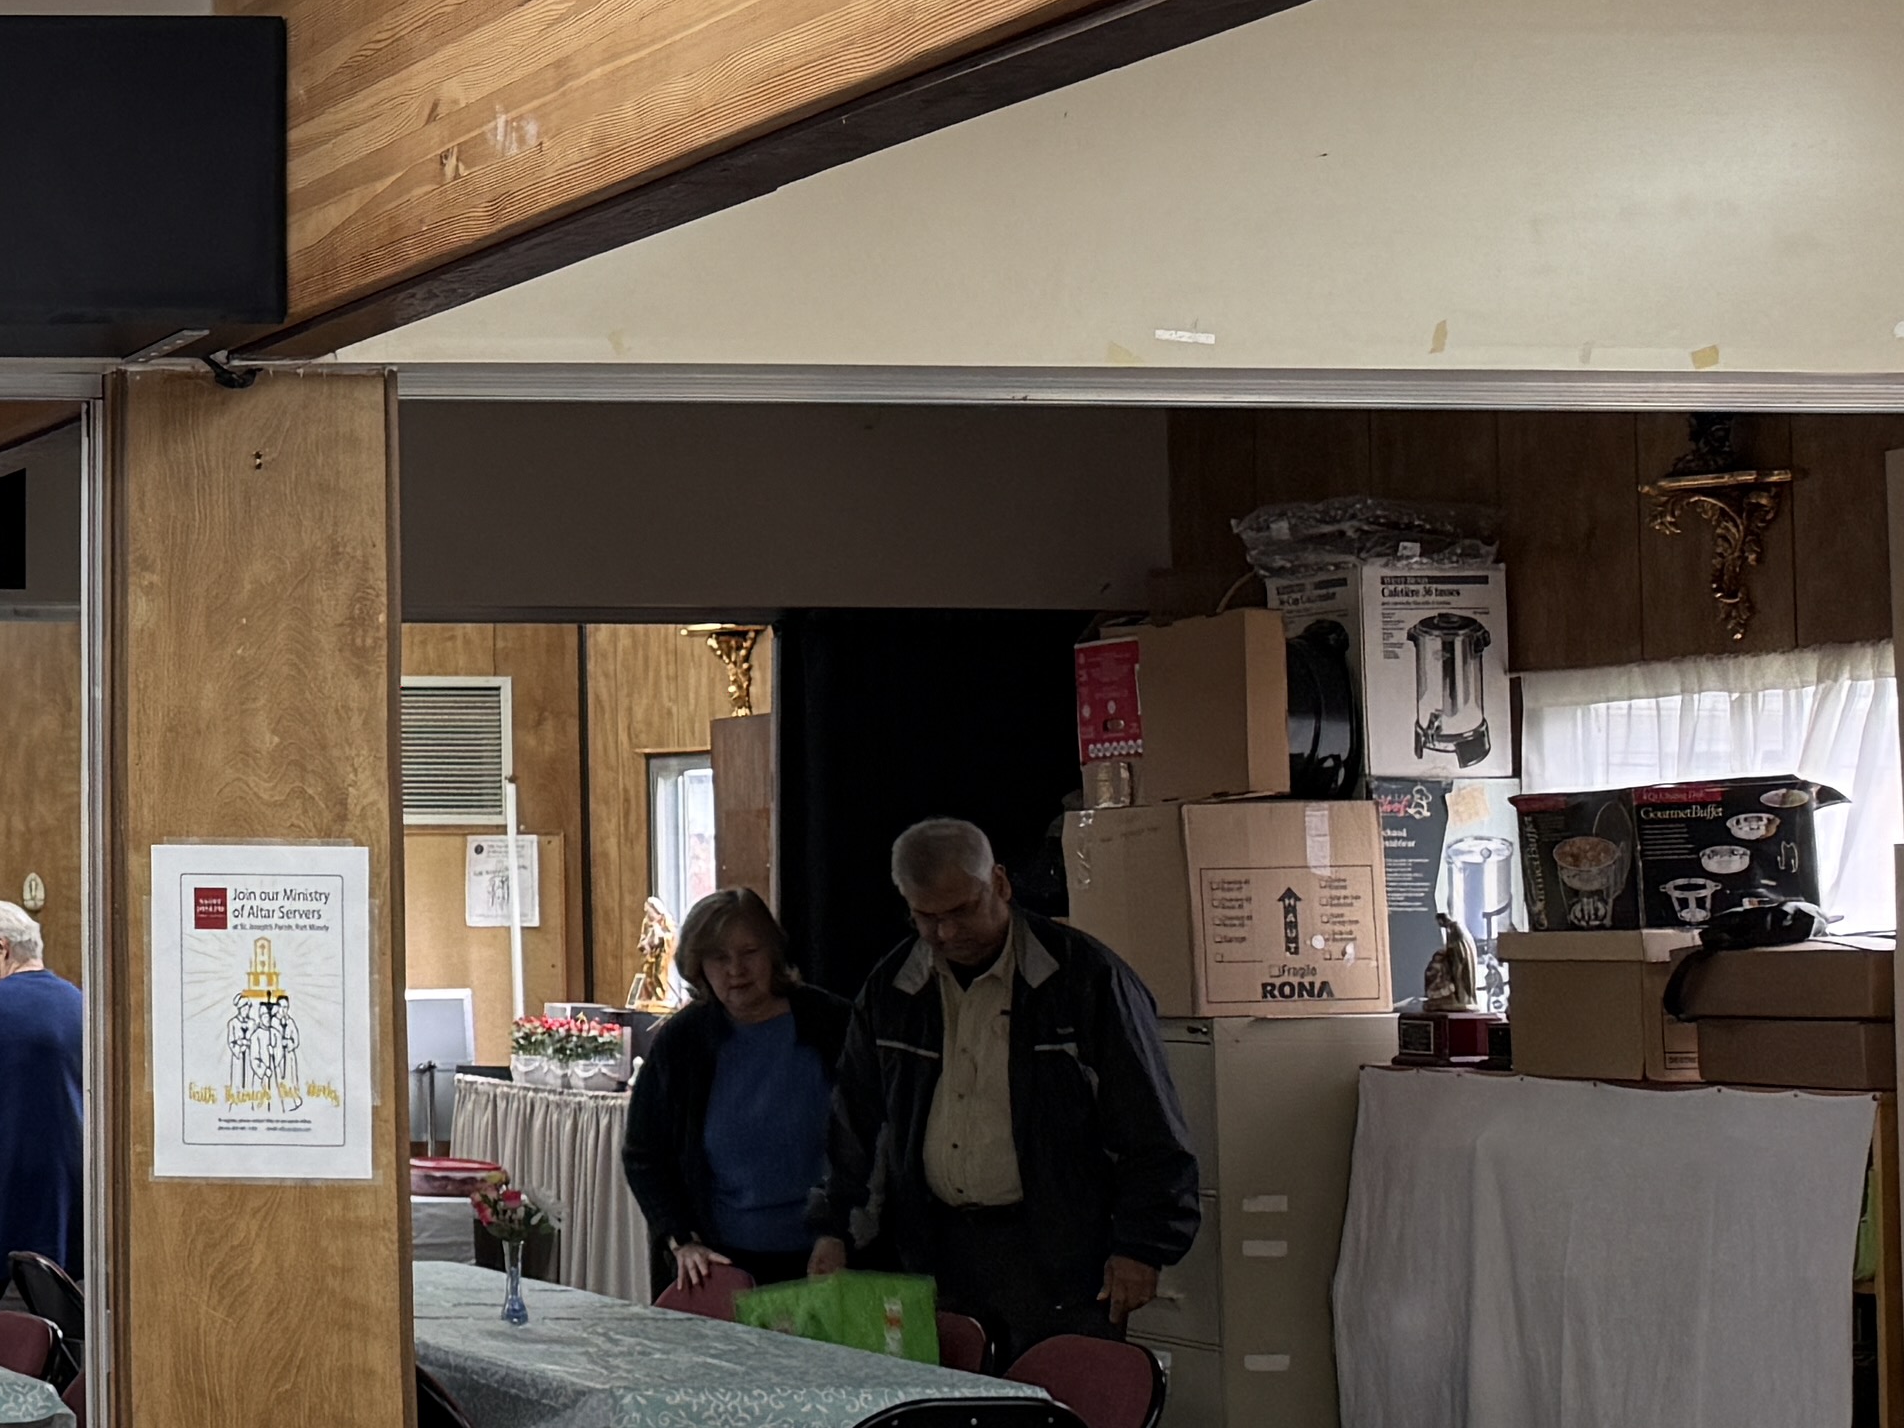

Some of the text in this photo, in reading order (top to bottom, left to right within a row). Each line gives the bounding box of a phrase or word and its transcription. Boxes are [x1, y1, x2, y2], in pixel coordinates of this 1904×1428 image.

[232, 887, 330, 904] Join our Ministry
[232, 904, 321, 920] of Altar Servers
[1284, 897, 1299, 953] HAUT
[1261, 981, 1334, 999] RONA
